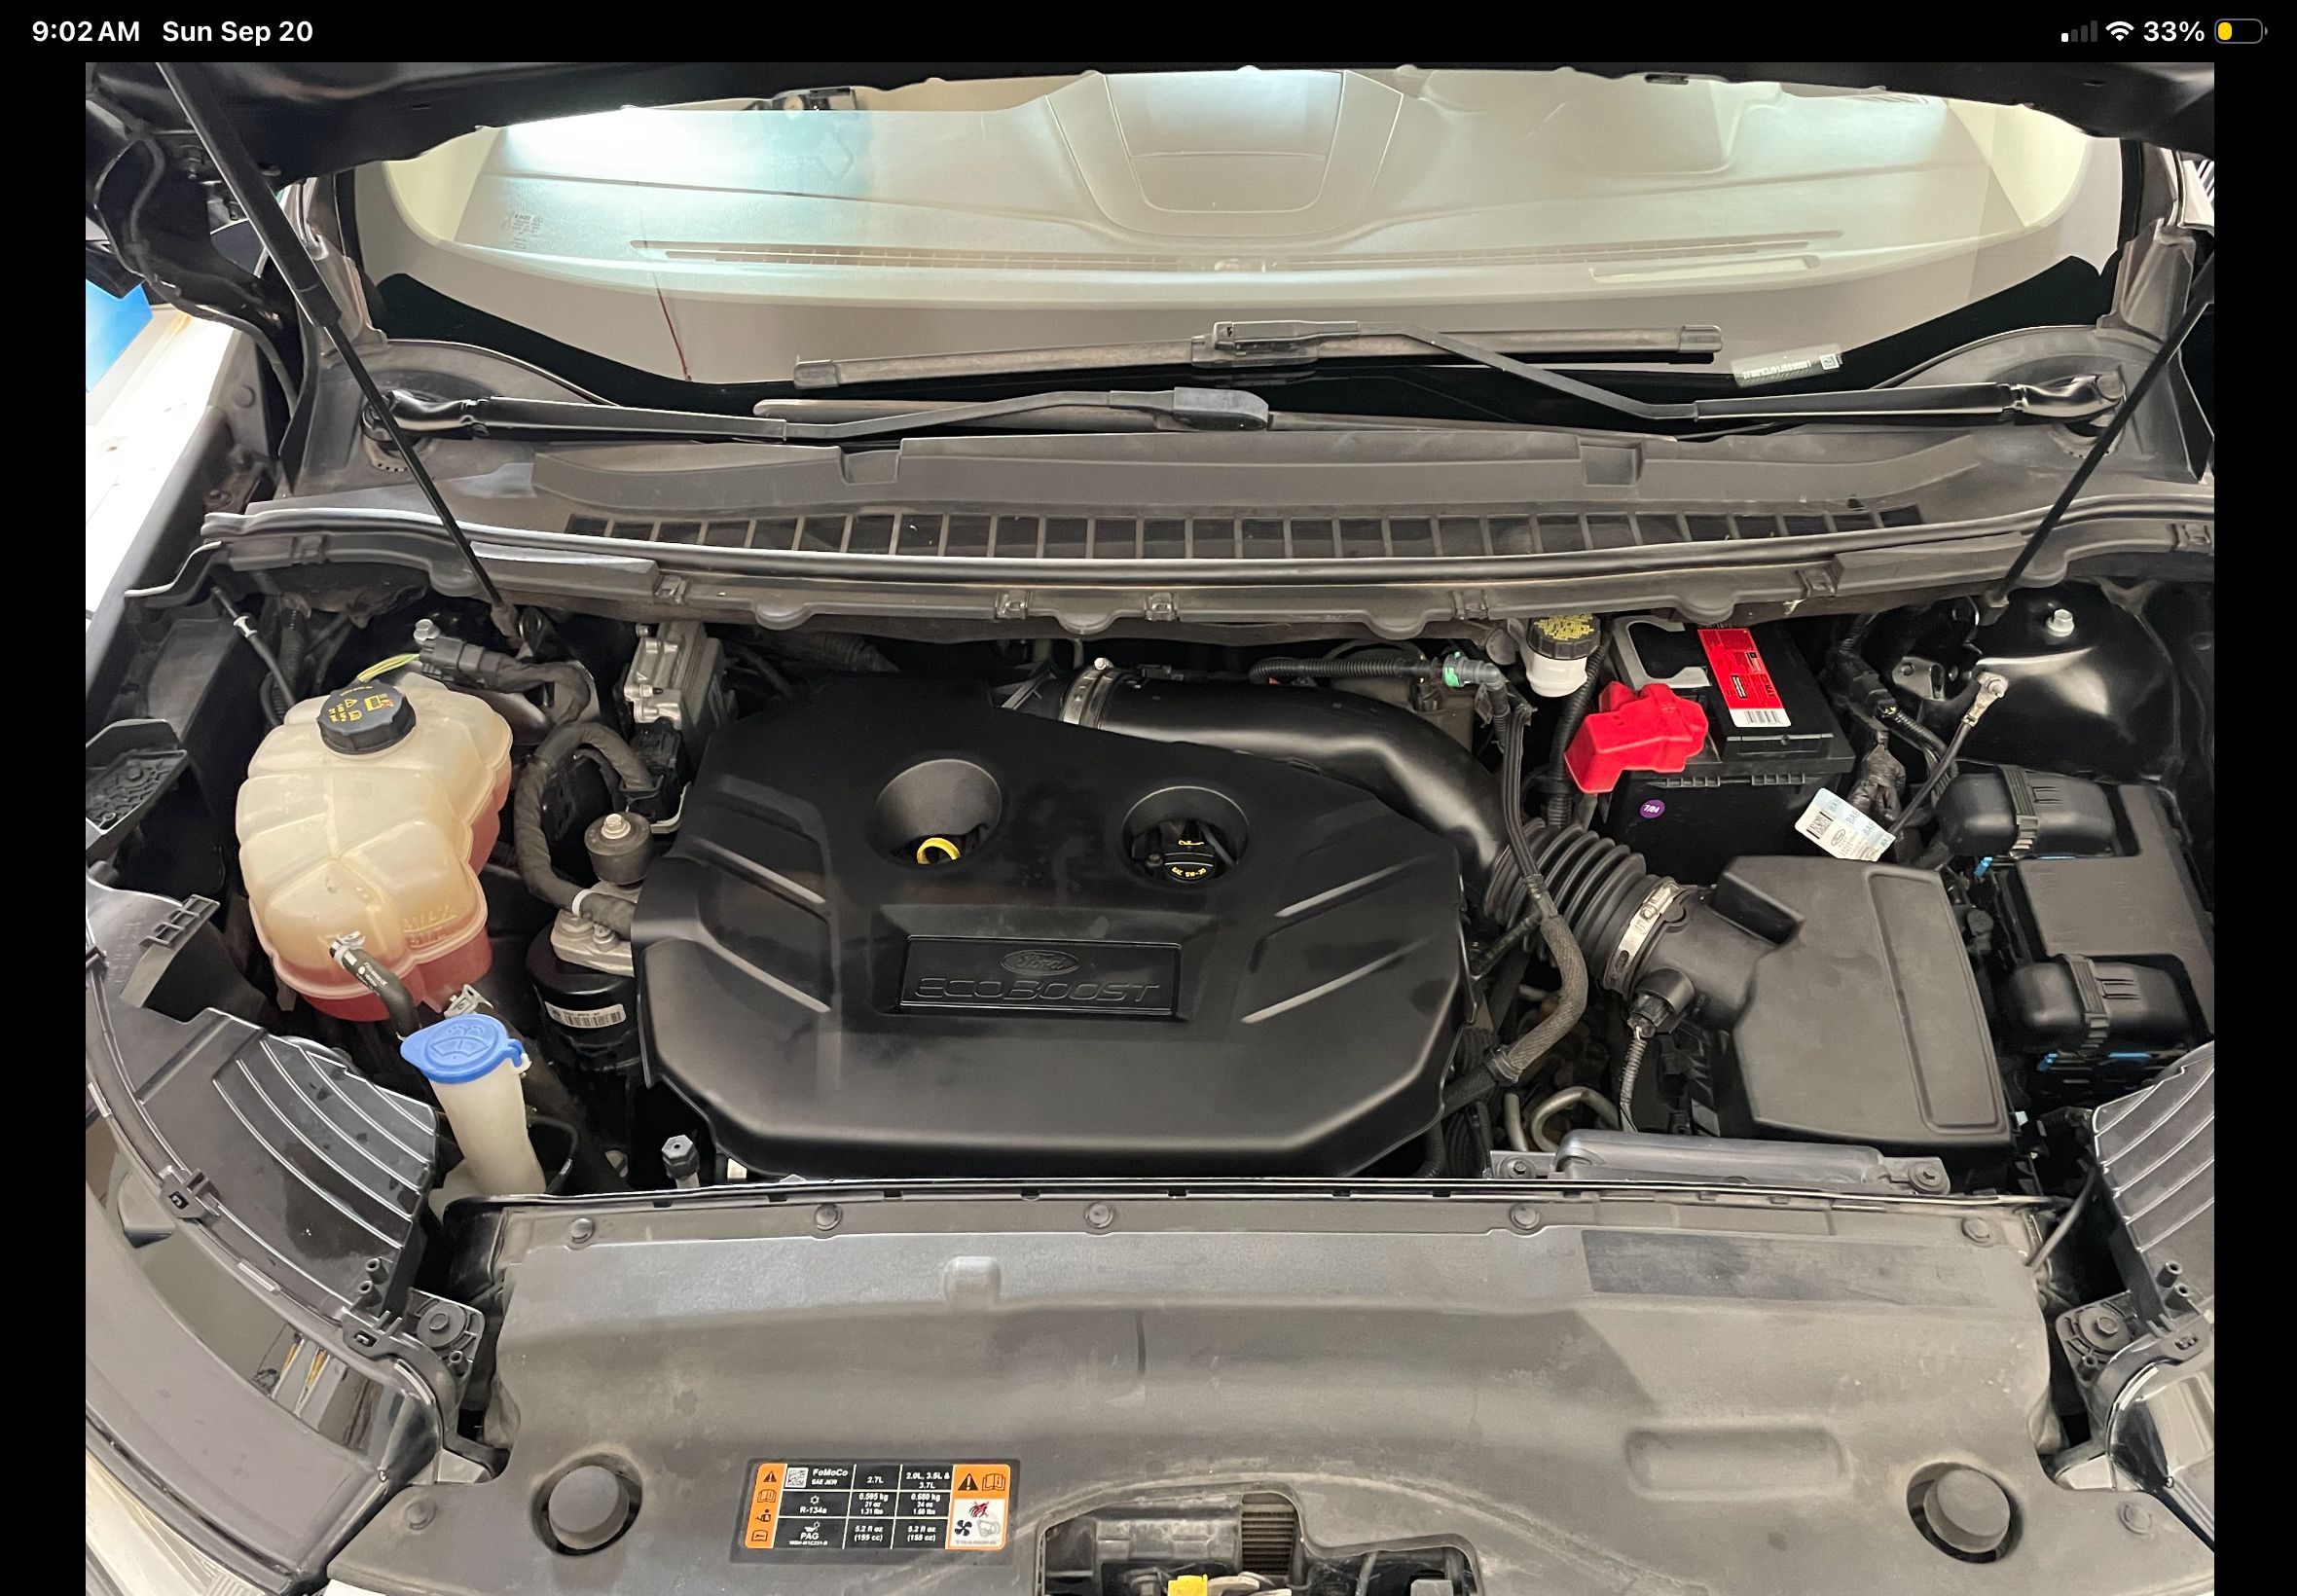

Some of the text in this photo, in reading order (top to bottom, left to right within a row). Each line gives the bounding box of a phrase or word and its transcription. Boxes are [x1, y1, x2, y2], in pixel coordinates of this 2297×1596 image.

[914, 977, 1161, 1002] ECOBOOST
[812, 1468, 849, 1476] FoMoCo
[866, 1475, 884, 1484] 2.7L
[879, 1493, 889, 1503] kg
[799, 1505, 827, 1514] R-134a
[800, 1532, 820, 1541] PAG
